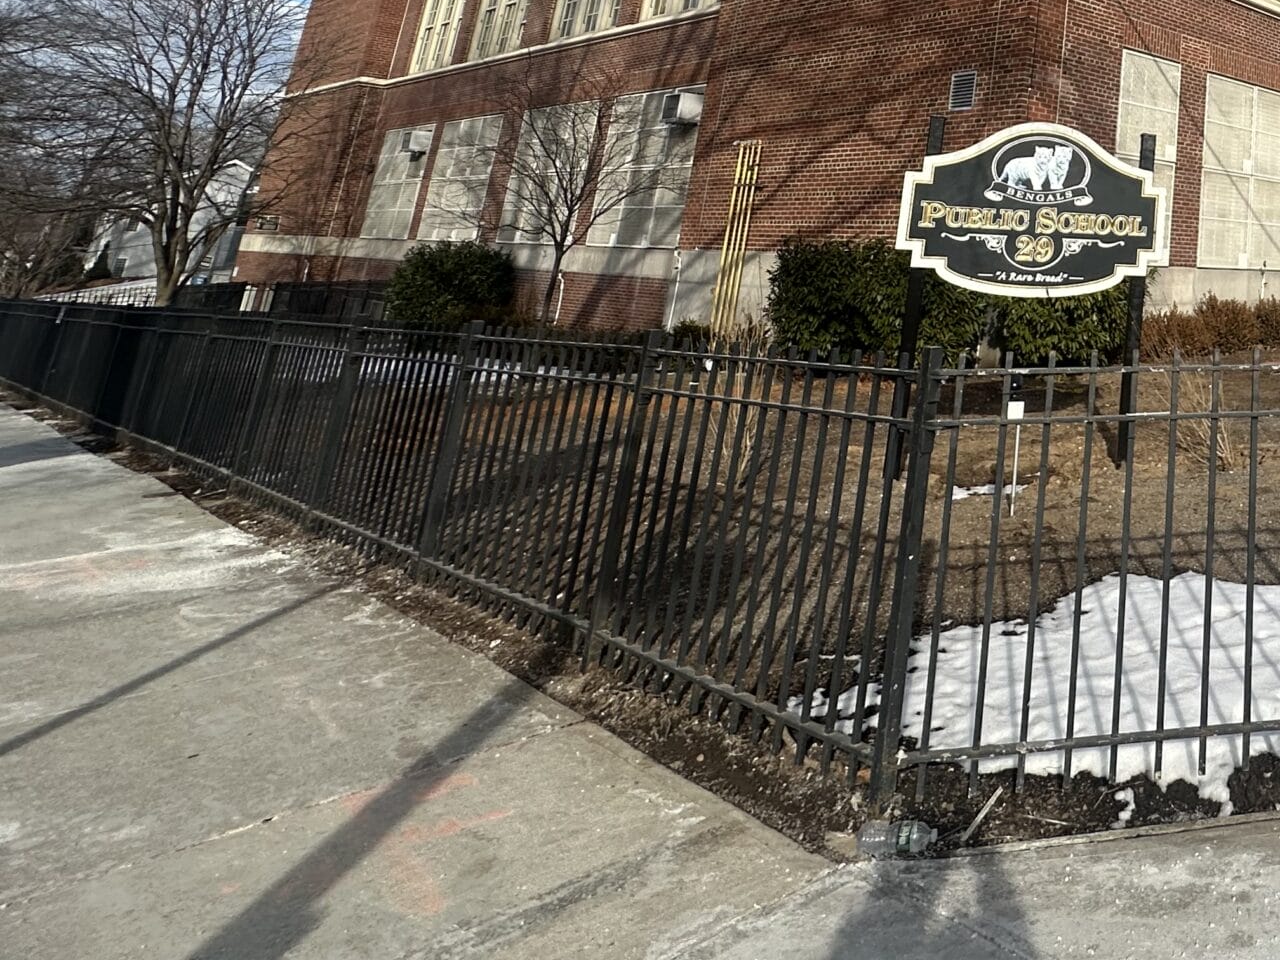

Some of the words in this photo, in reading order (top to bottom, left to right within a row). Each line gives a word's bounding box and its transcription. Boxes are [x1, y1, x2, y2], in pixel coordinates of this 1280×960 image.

[1006, 187, 1073, 203] BENGALS
[918, 200, 1030, 231] PUBLIC
[1035, 207, 1147, 237] SCHOOL
[1014, 235, 1055, 263] 29
[1009, 272, 1034, 282] Rare
